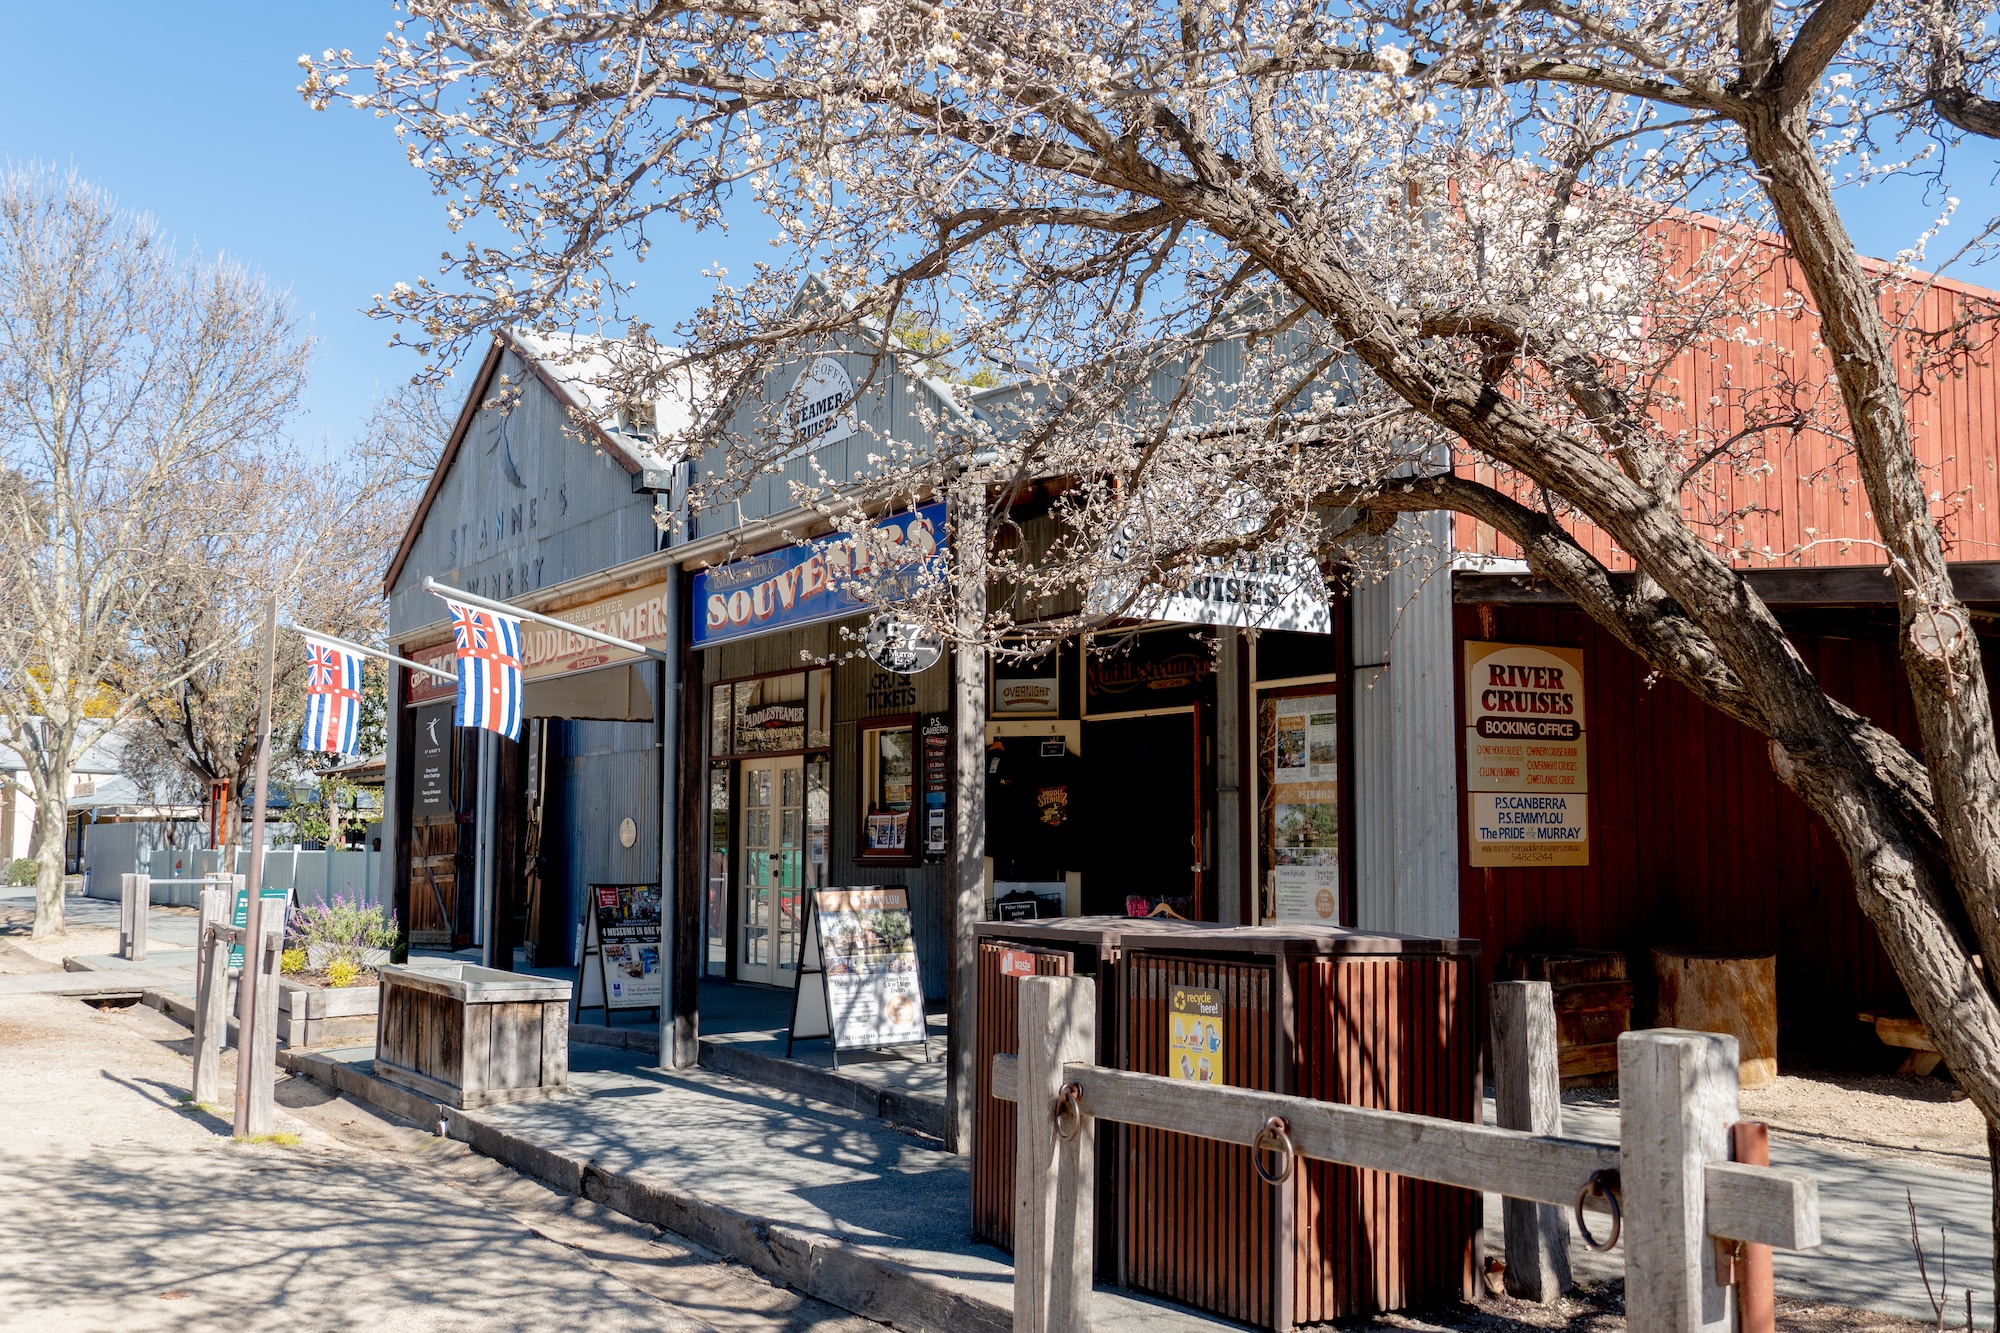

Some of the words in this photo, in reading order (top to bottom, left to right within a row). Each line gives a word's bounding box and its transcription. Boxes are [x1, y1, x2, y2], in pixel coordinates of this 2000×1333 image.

[449, 523, 468, 561] ST
[478, 482, 568, 550] ANNE'S
[466, 556, 544, 600] WINERY
[706, 518, 937, 631] SOUVENIRS
[595, 599, 623, 618] RIVER
[887, 623, 925, 651] 57
[890, 650, 917, 658] Murray
[576, 657, 601, 669] ECHUCA
[1488, 664, 1564, 690] RIVER
[1003, 686, 1051, 697] OVERNIGHT
[866, 687, 917, 711] TICKETS
[1481, 689, 1574, 715] CRUISES
[744, 706, 804, 728] PADDLESTEAMER
[1485, 720, 1536, 736] BOOKING
[1539, 721, 1574, 737] OFFICE
[1482, 745, 1492, 755] ONE
[1492, 745, 1504, 755] HOUR
[1504, 746, 1523, 756] CRUISES
[1531, 746, 1548, 757] WINERY
[1548, 747, 1564, 757] CRUISE
[1531, 760, 1558, 771] OVERNIGHT
[1558, 761, 1578, 771] CRUISES
[1485, 767, 1501, 777] LUNCH
[1504, 767, 1520, 777] DINNER
[1531, 774, 1558, 785] WETLANDS
[1559, 775, 1575, 785] CRUISE
[1298, 790, 1306, 799] PS
[1306, 789, 1336, 799] EMMYLOU
[1480, 827, 1497, 839] The
[1499, 827, 1525, 839] PRIDE
[1537, 827, 1581, 839] MURRAY
[861, 895, 900, 906] EMMYLOU
[607, 926, 636, 936] MUSEUMS
[636, 926, 644, 935] IN
[644, 926, 656, 935] ONE
[1014, 960, 1031, 972] waste
[1187, 992, 1212, 1005] recycle
[1200, 1003, 1218, 1014] here!
